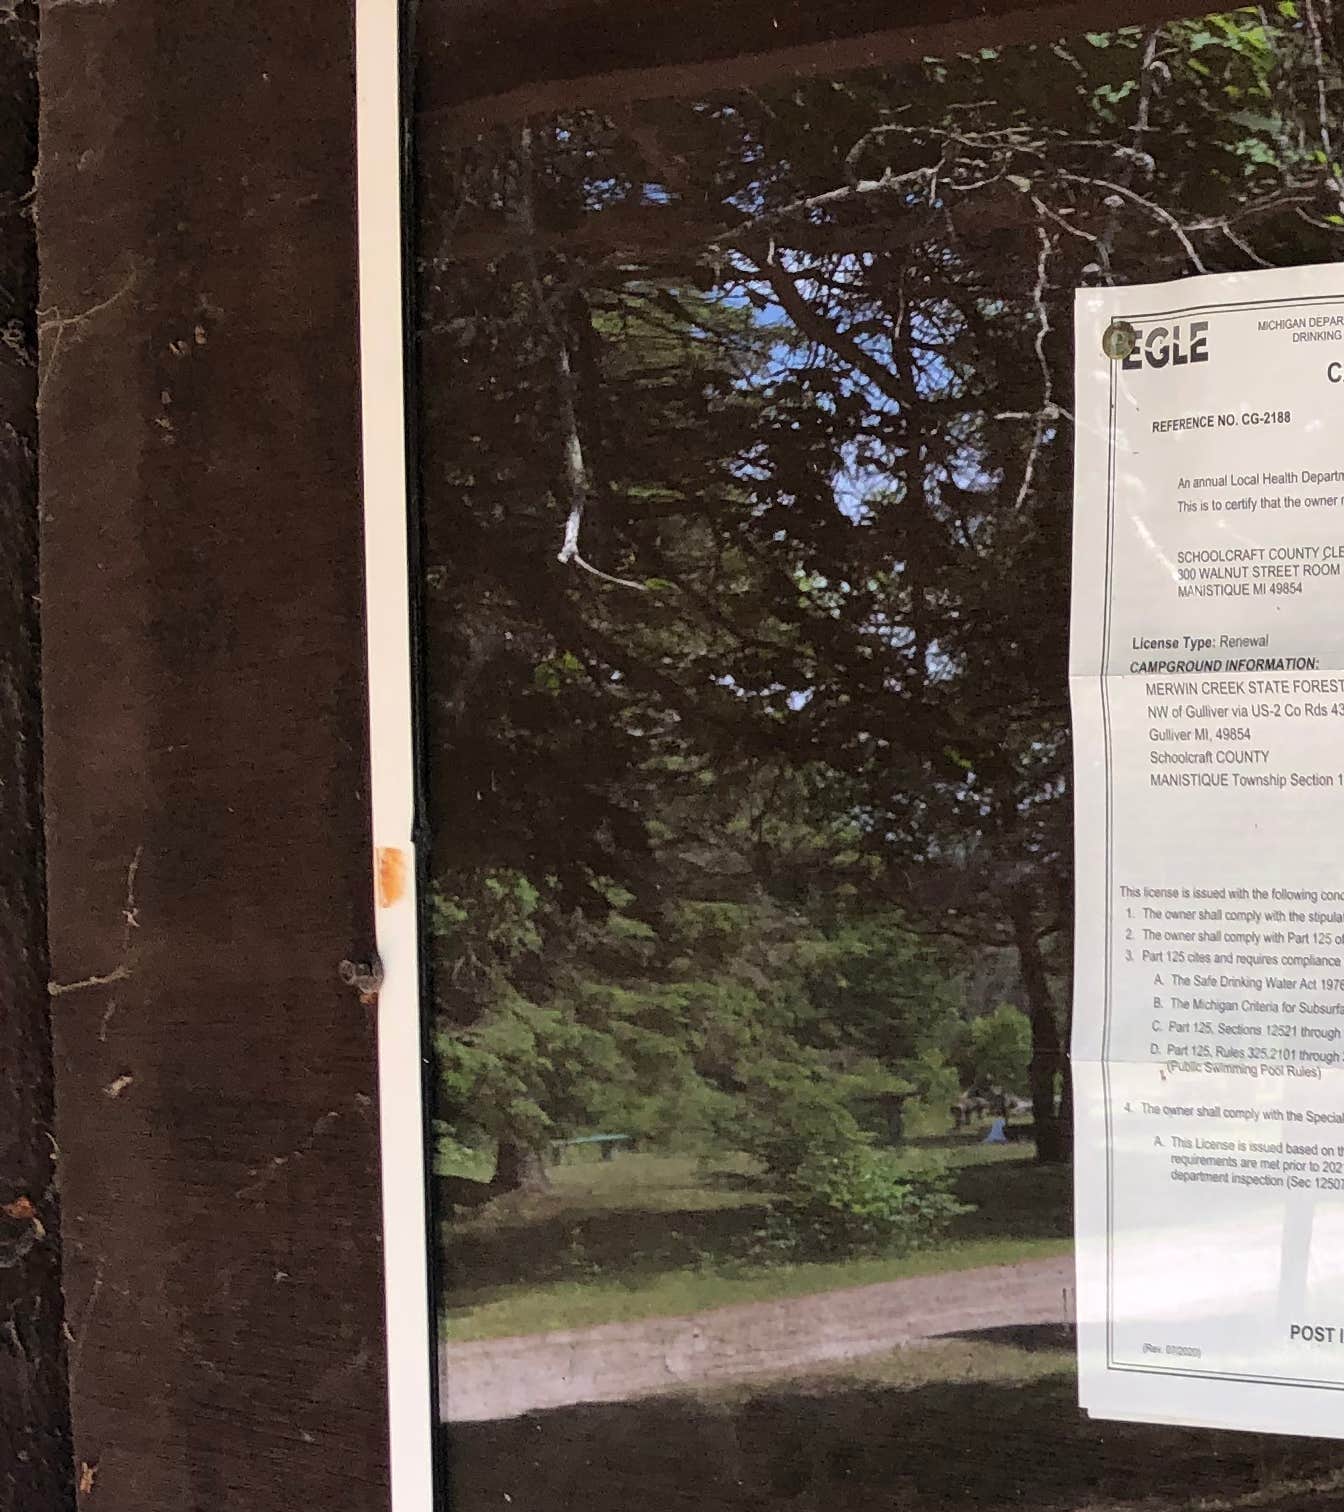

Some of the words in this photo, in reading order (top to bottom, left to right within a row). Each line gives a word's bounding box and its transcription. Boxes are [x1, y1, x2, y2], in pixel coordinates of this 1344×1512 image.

[1257, 317, 1307, 331] MICHIGAN
[1122, 322, 1208, 370] EGLE
[1152, 415, 1215, 433] REFERENCE
[1217, 413, 1239, 427] NO.
[1241, 410, 1291, 426] CG-2188
[1177, 548, 1266, 564] SCHOOLCRAFT
[1268, 546, 1320, 561] COUNTY
[1177, 567, 1197, 581] 300
[1198, 565, 1250, 580] WALNUT
[1251, 564, 1300, 579] STREET
[1302, 563, 1341, 577] ROOM
[1177, 582, 1251, 598] MANISTIQUE
[1252, 582, 1267, 595] MI
[1269, 581, 1303, 595] 49854
[1132, 636, 1180, 650] License
[1182, 635, 1216, 652] Type:
[1219, 633, 1269, 649] Renewal
[1129, 659, 1223, 675] CAMPGROUND
[1224, 656, 1320, 673] INFORMATION:
[1145, 681, 1199, 696] MERWIN
[1201, 680, 1246, 696] CREEK
[1248, 679, 1290, 695] STATE
[1290, 1324, 1336, 1343] POST
